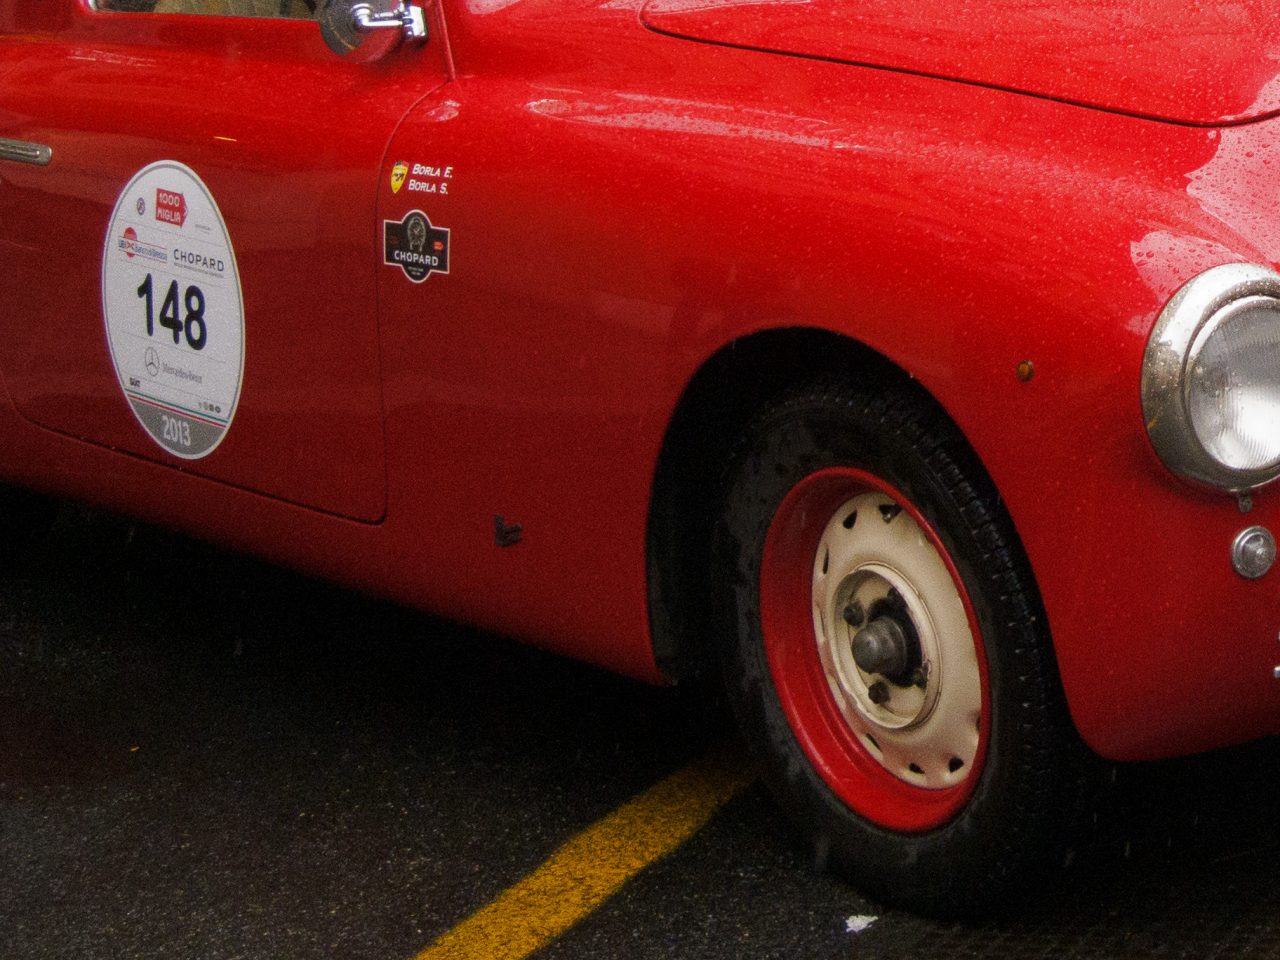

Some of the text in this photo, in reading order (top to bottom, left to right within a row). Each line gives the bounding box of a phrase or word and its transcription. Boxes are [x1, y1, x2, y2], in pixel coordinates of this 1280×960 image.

[158, 192, 180, 207] 1000
[157, 208, 182, 223] MIGLIA
[173, 248, 225, 272] CHOPARD
[394, 250, 439, 266] CHOPARD
[137, 272, 208, 351] 148
[161, 414, 191, 447] 2013
